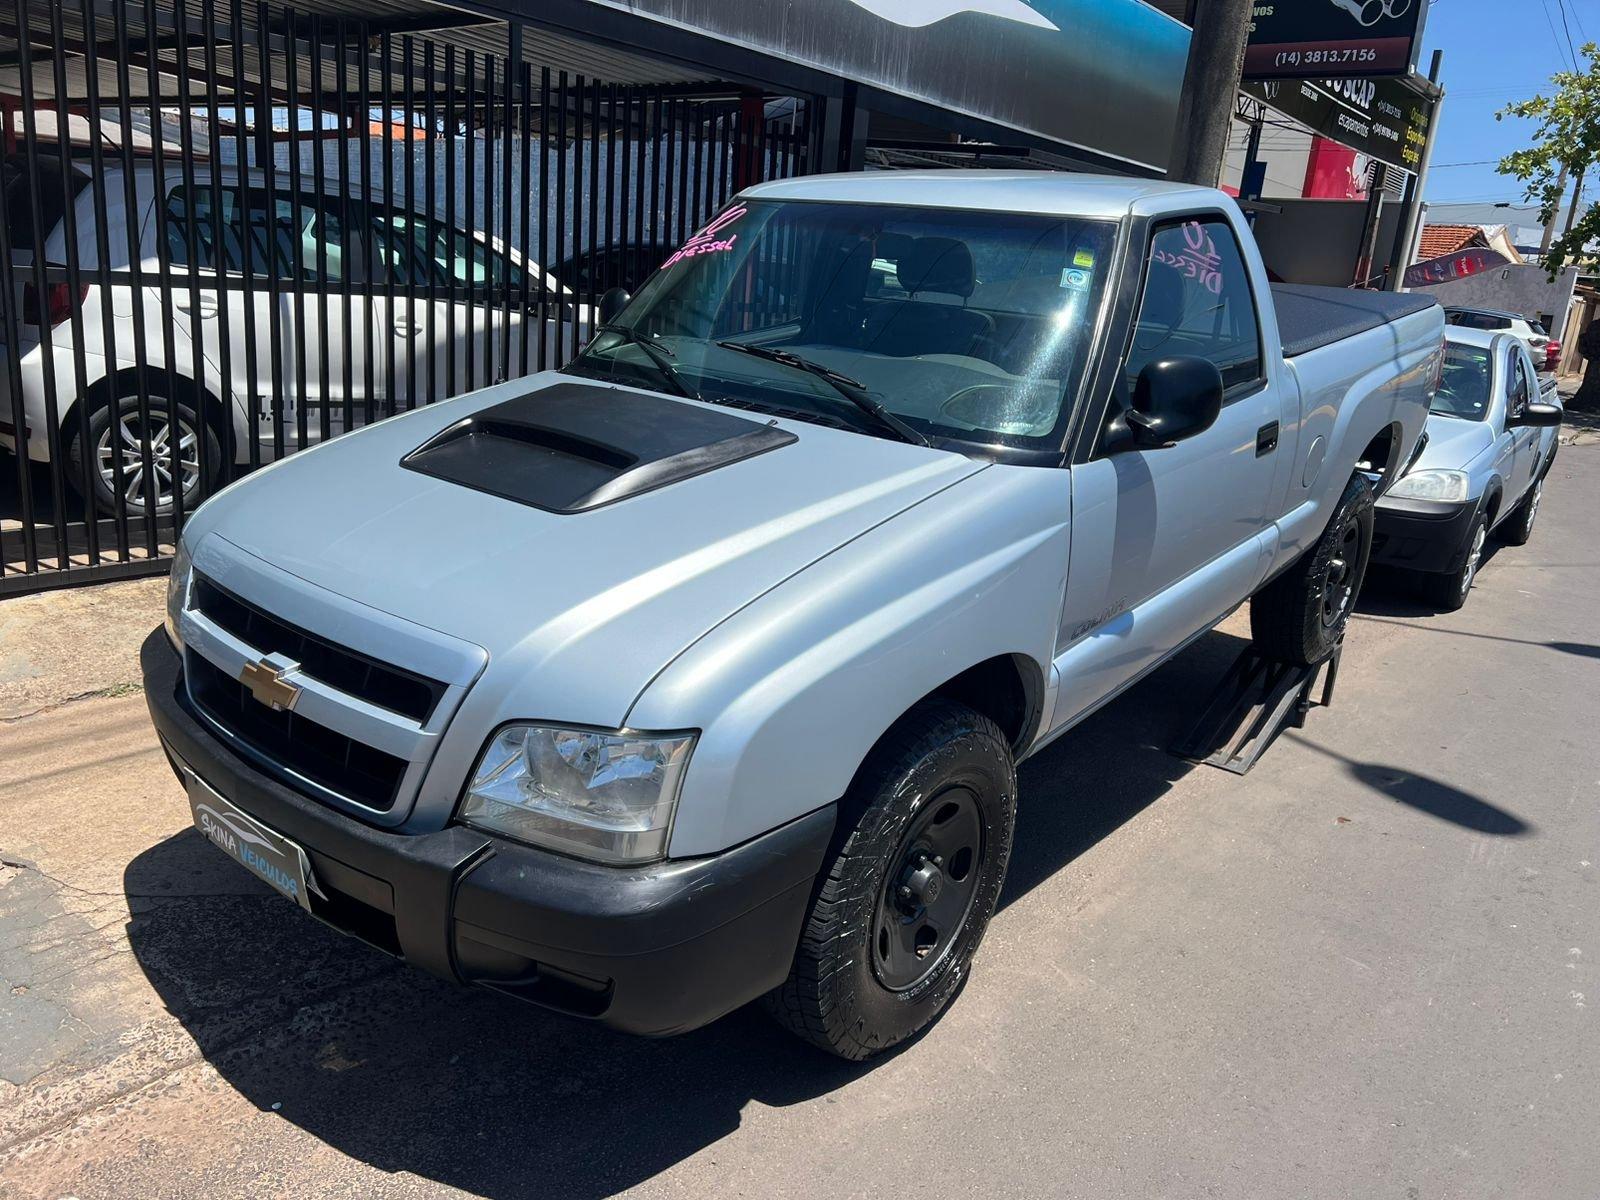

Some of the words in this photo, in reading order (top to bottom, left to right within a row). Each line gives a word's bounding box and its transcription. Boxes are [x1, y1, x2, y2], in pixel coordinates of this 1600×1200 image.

[1275, 51, 1301, 67] (14)
[1304, 48, 1377, 63] 3813.7156
[200, 813, 238, 855] SKINA
[239, 842, 299, 897] VEICULOS
